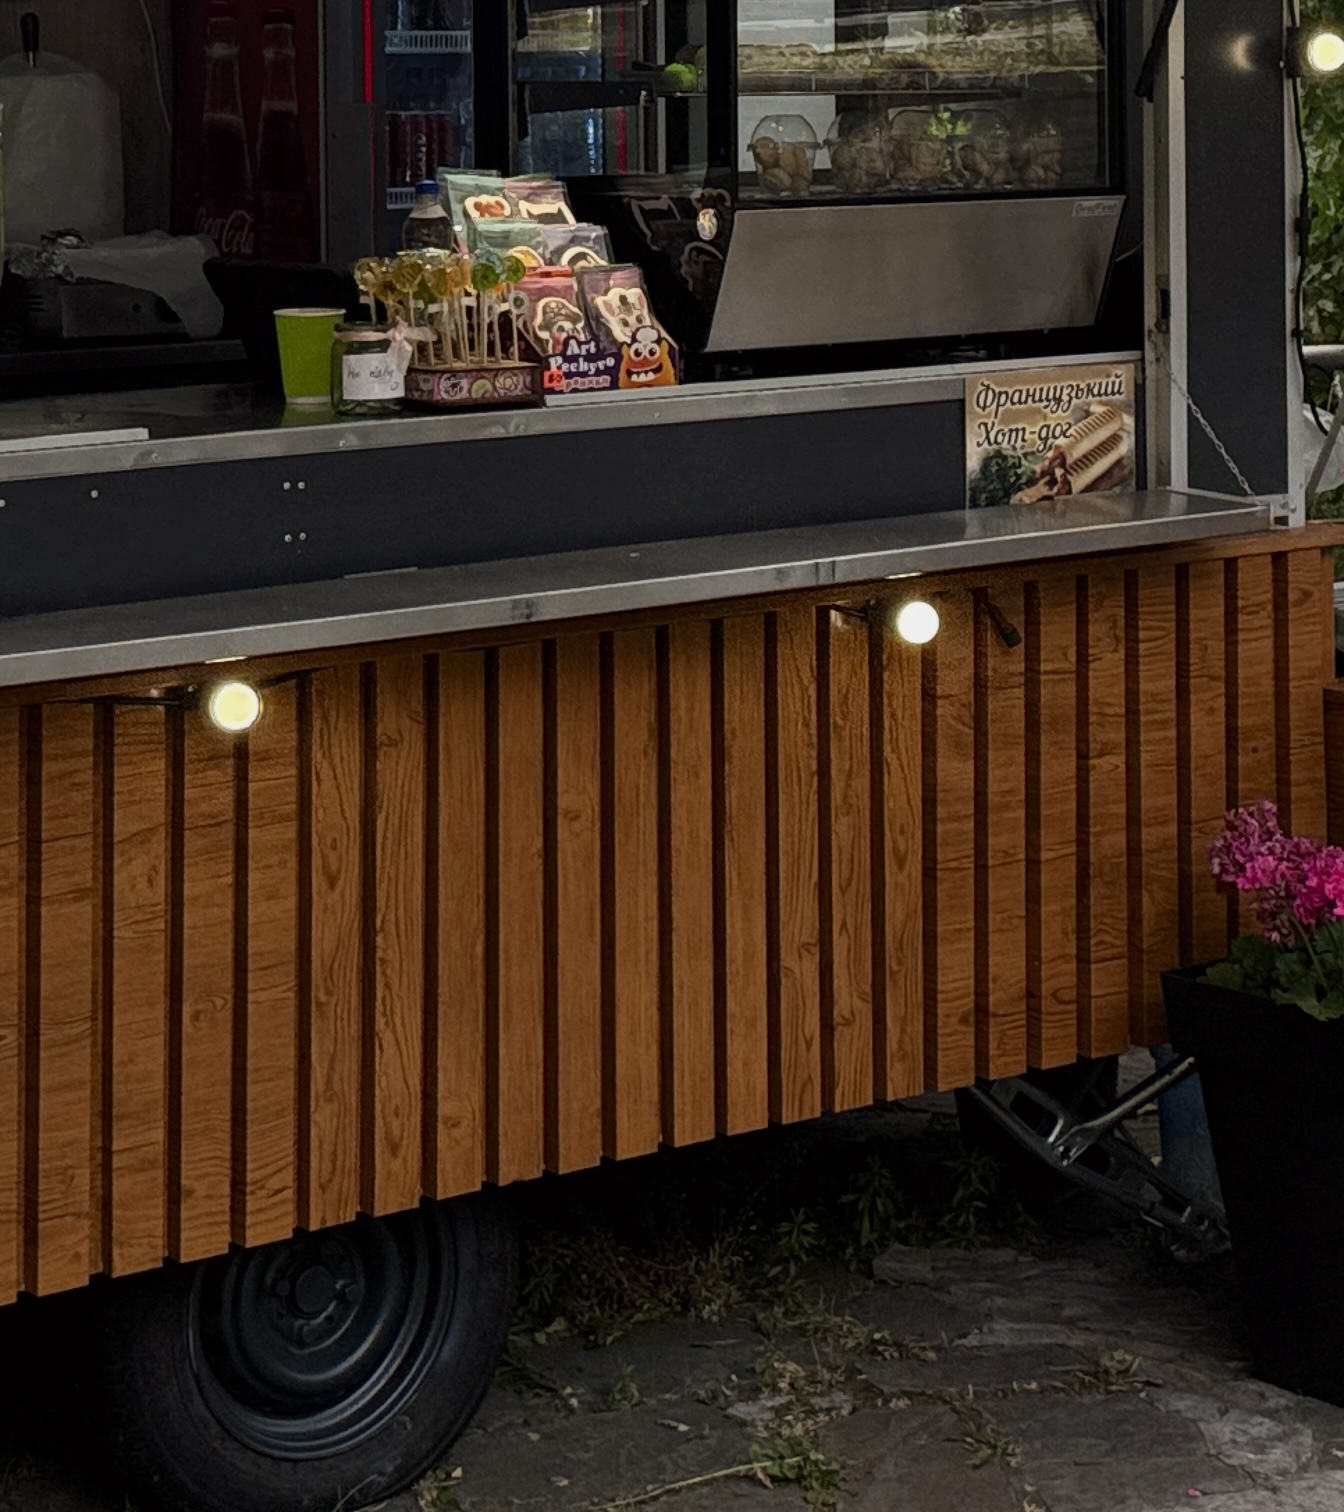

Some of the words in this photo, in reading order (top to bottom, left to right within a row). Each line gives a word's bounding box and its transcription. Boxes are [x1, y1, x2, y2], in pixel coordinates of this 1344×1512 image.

[565, 338, 597, 356] Art
[547, 354, 616, 375] Pechyvo
[975, 371, 1125, 419] Французький
[976, 420, 1073, 454] Хот-дог
